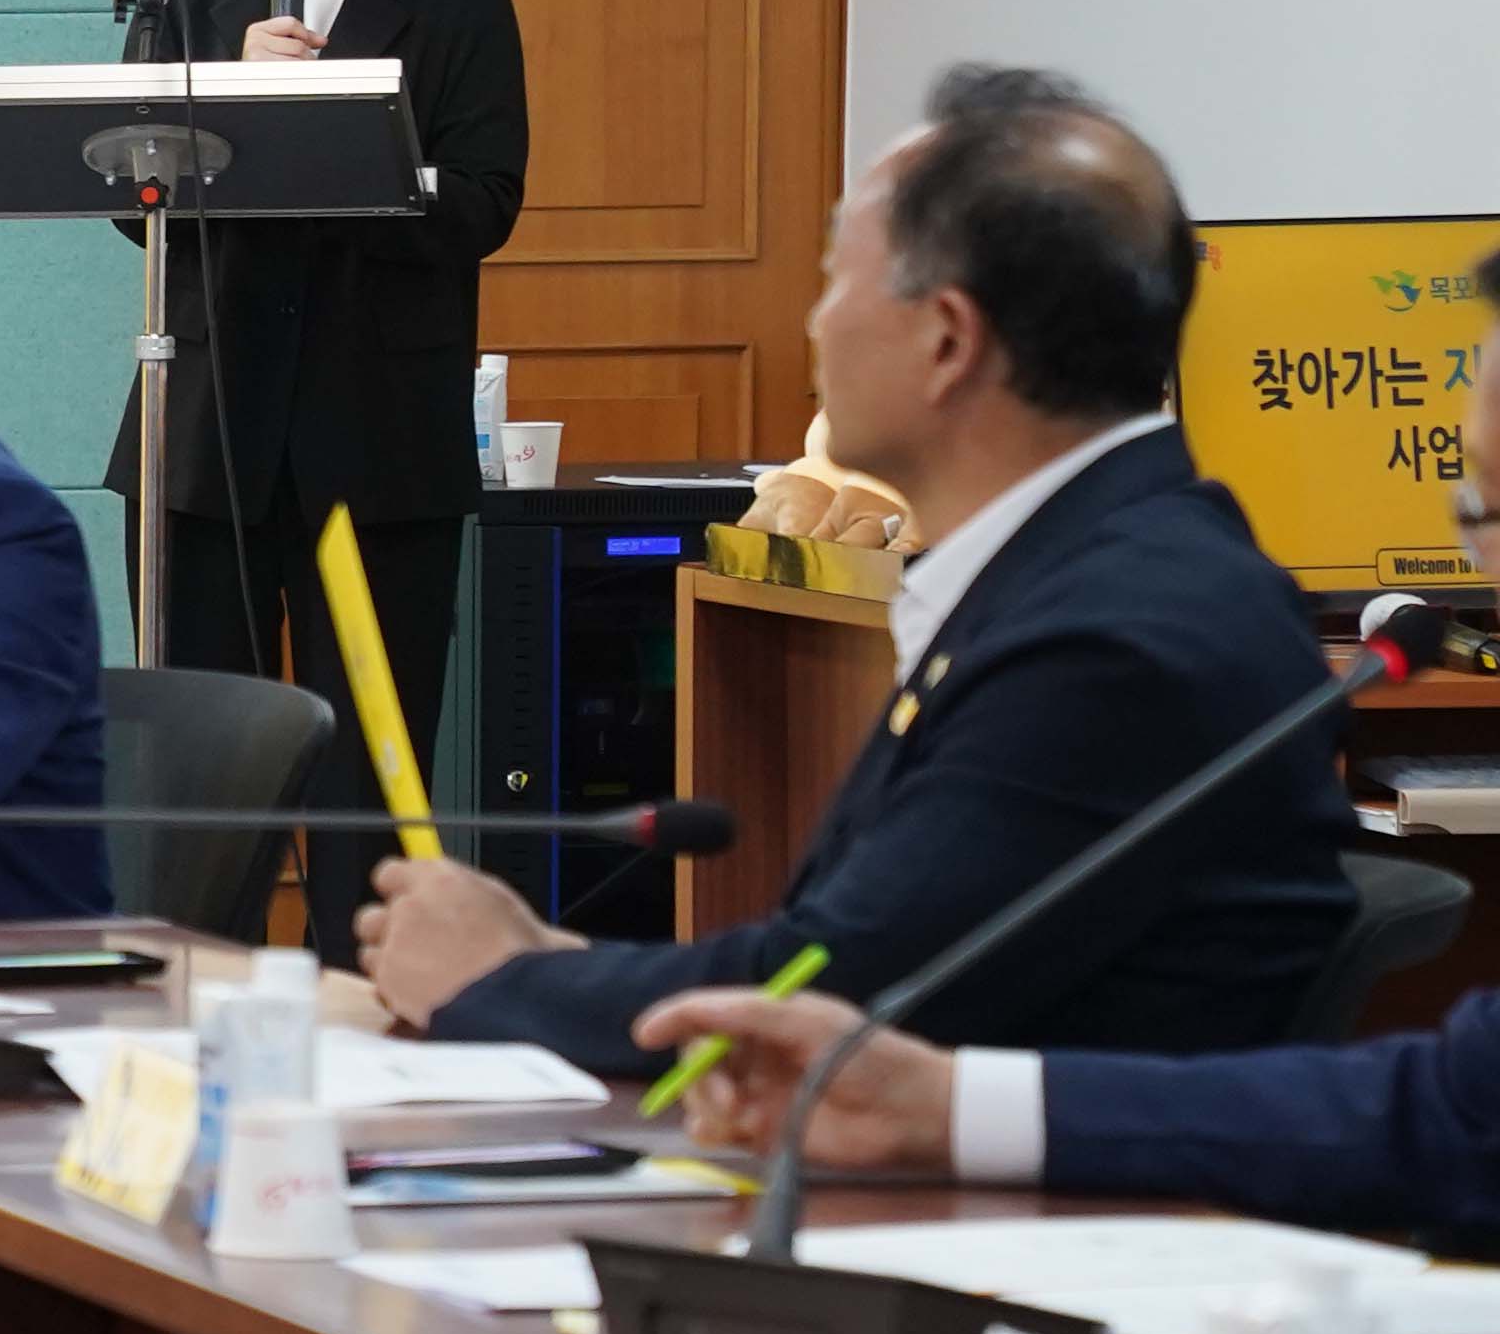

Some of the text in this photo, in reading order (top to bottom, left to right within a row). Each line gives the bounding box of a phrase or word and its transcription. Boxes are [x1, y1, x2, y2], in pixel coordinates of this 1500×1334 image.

[1430, 276, 1478, 303] 목포
[1252, 346, 1428, 411] 찾아가는
[1388, 424, 1464, 482] 사업
[1393, 557, 1455, 575] Welcome
